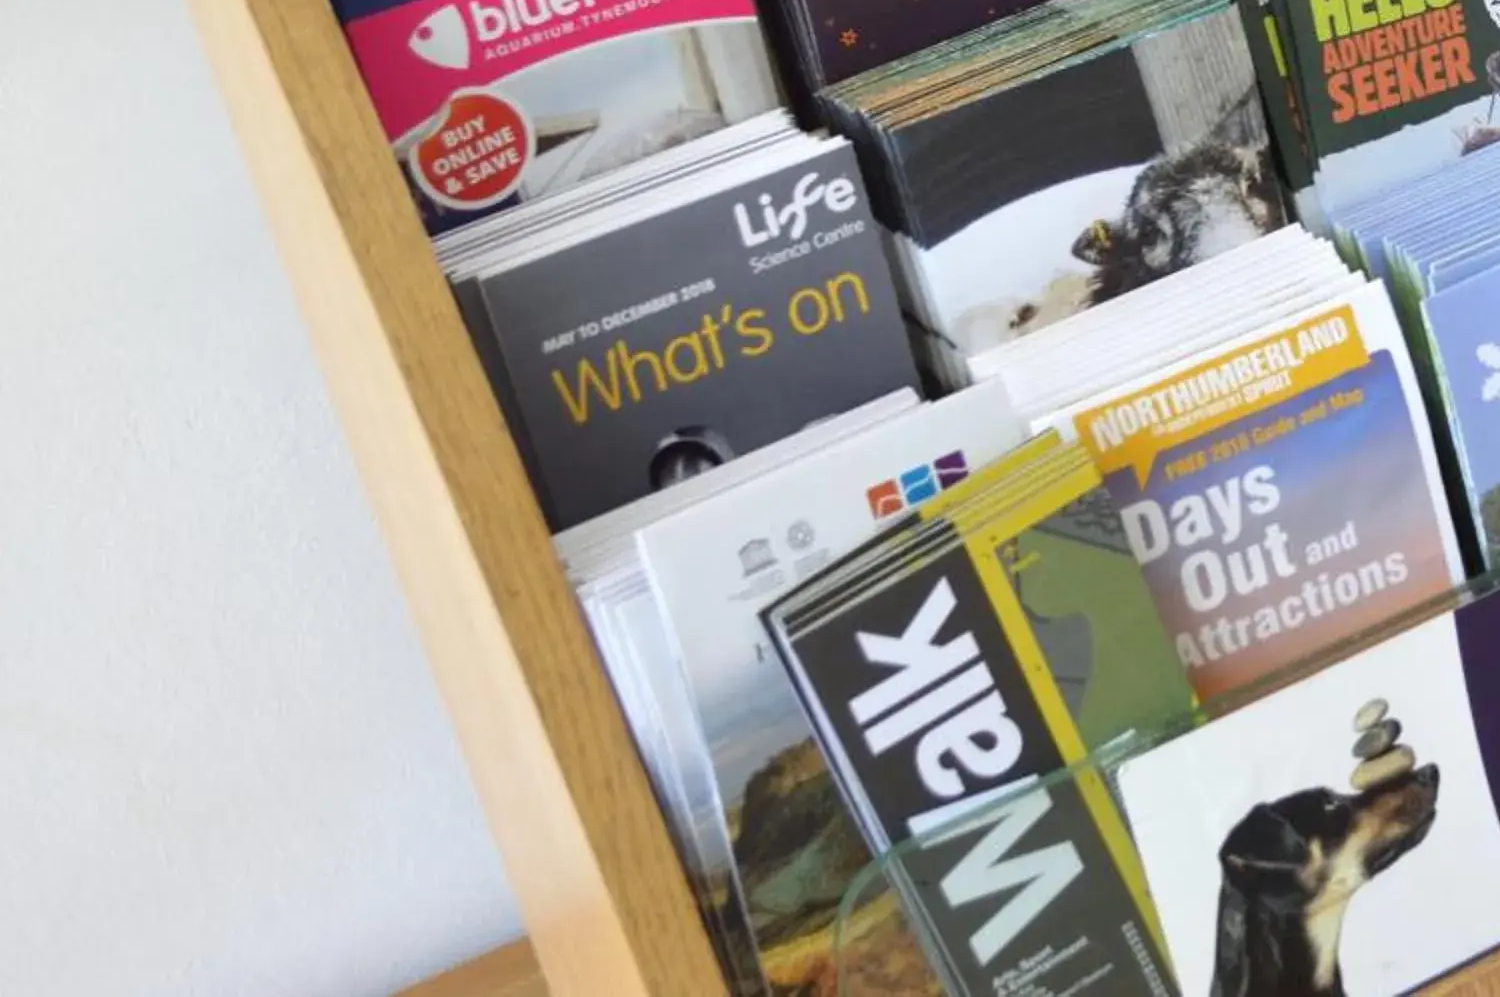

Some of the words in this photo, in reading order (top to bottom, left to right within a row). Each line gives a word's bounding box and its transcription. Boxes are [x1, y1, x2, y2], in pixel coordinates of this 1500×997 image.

[1321, 3, 1468, 74] ADVENTURE
[1326, 35, 1477, 125] SEEKER
[432, 125, 517, 176] ONLINE
[440, 115, 486, 150] BUY
[443, 175, 464, 195] &
[467, 149, 522, 186] SAVE
[733, 171, 857, 248] Life
[748, 238, 812, 274] Science
[813, 219, 866, 250] Centre
[541, 332, 577, 355] MAY
[578, 321, 601, 340] TO
[601, 292, 680, 331] DECEMBER
[680, 278, 717, 302] 2018
[551, 304, 775, 424] What's
[788, 271, 871, 334] on
[1089, 315, 1350, 454] NORTHUMBERLAND
[1251, 416, 1297, 447] Guide
[1299, 401, 1327, 426] and
[1120, 464, 1282, 566] Days
[1179, 521, 1297, 614] Out
[1304, 519, 1359, 566] and
[1174, 551, 1409, 669] Attractions
[847, 575, 1088, 969] Walk
